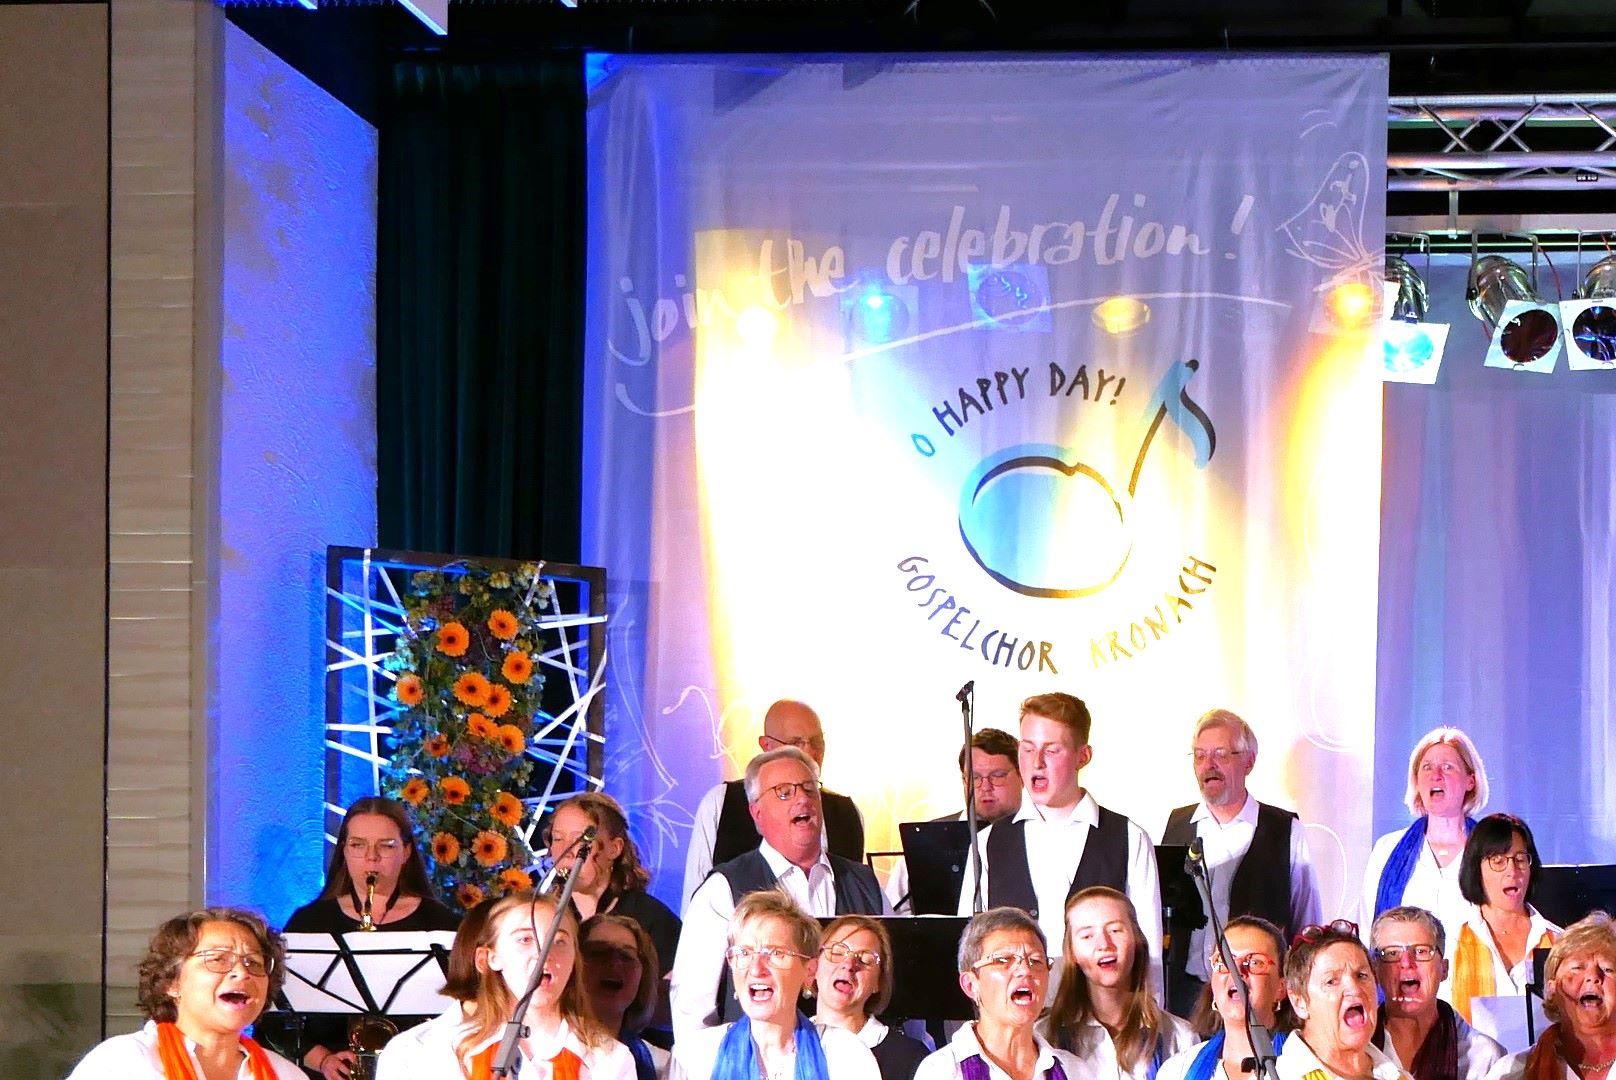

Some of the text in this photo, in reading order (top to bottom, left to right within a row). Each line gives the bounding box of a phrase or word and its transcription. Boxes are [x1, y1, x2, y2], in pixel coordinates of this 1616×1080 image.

[608, 275, 738, 368] join
[756, 238, 862, 311] the
[911, 361, 1127, 457] O HAPPY DAY!
[897, 554, 1217, 675] GOSPELCHOR KRONACH
